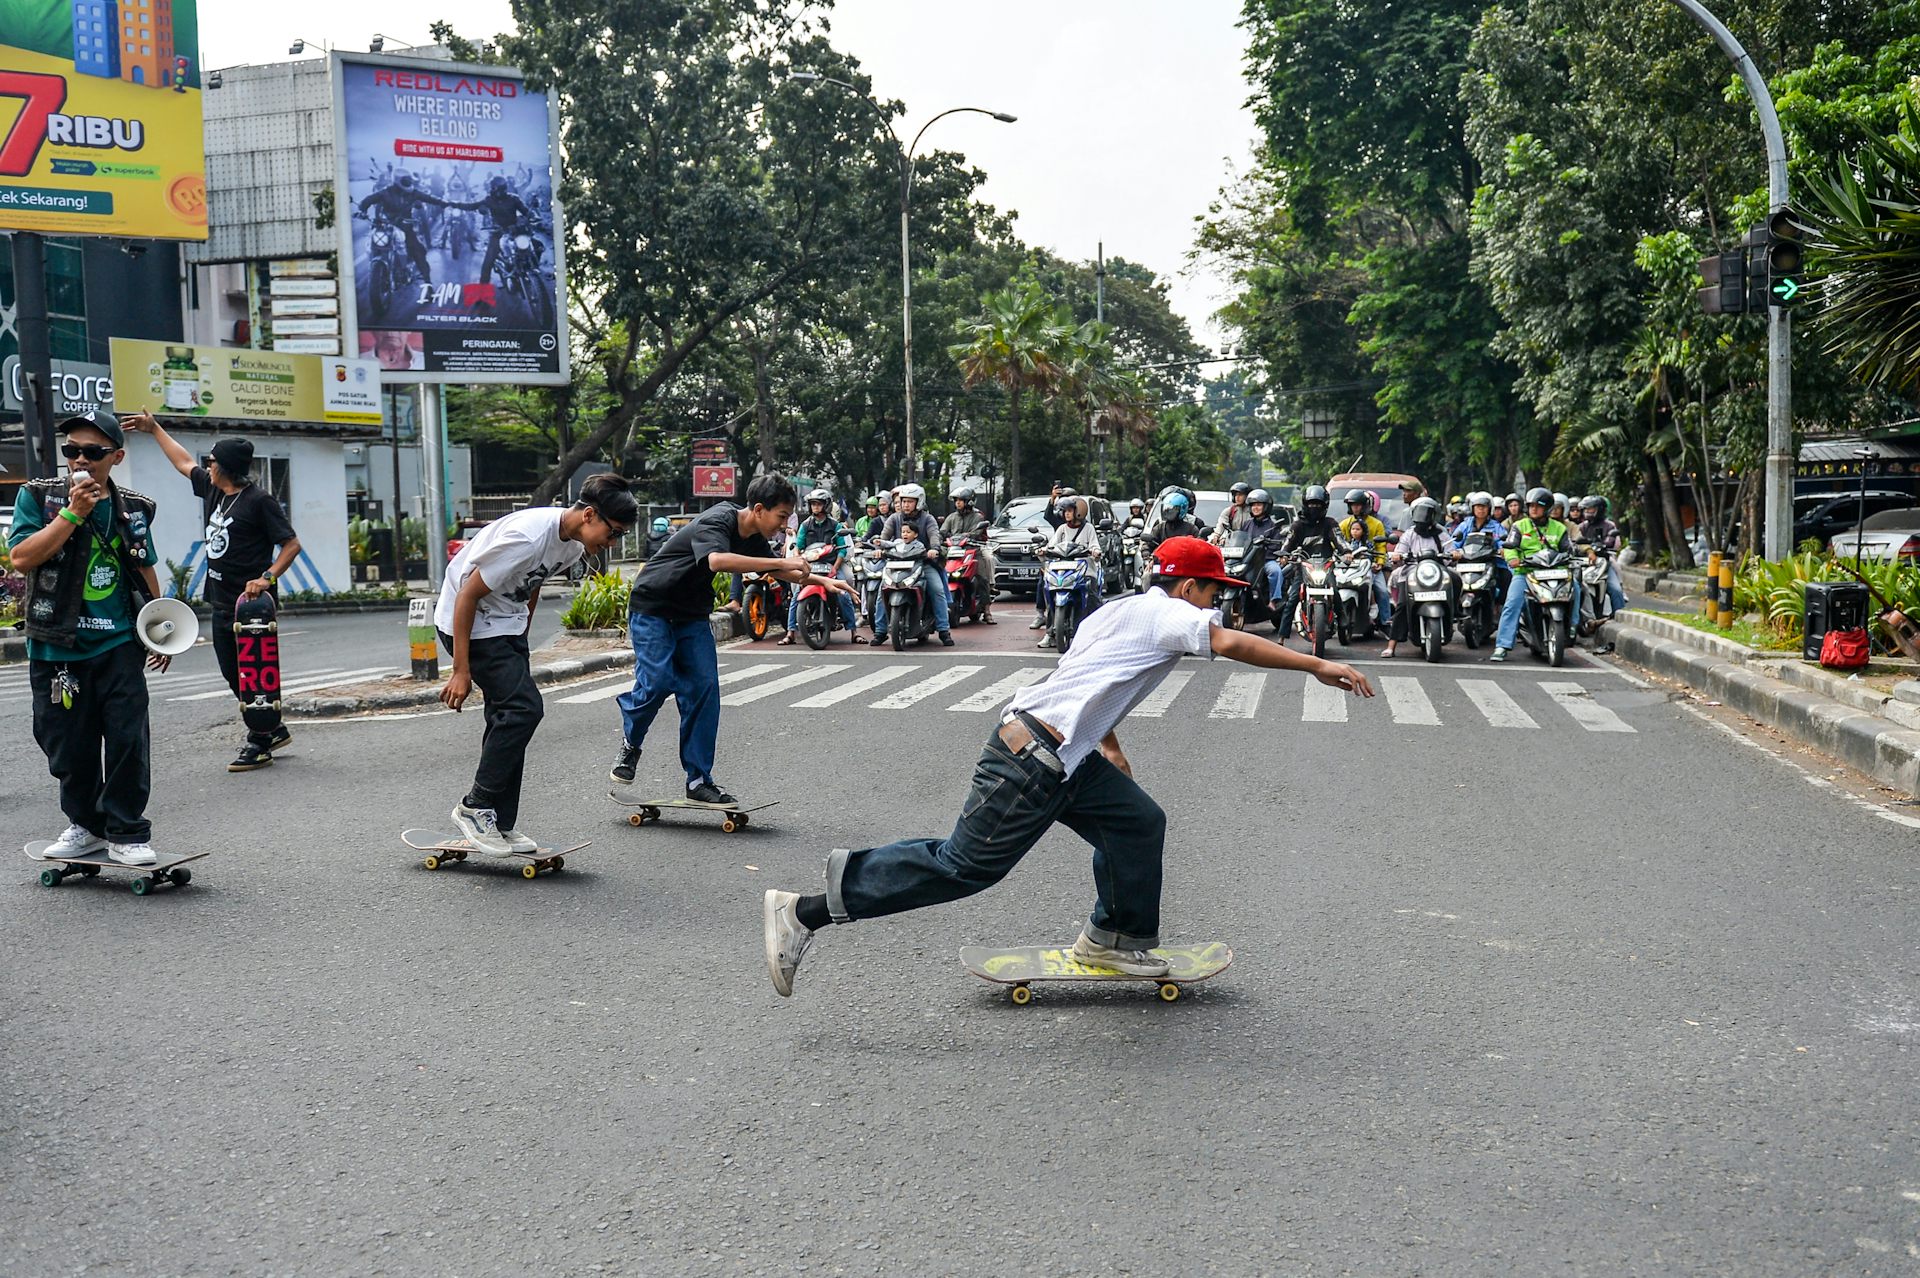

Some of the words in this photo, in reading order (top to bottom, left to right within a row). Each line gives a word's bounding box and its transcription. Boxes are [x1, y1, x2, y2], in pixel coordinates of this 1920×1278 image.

[374, 70, 517, 98] REDLAND
[394, 94, 445, 115] WHERE
[449, 98, 501, 120] RIDERS
[47, 114, 144, 151] RIBU
[421, 117, 477, 138] BELONG
[402, 143, 417, 153] RIDE
[446, 147, 454, 156] AT
[114, 166, 155, 175] superbank
[21, 191, 88, 211] Sekarang!
[416, 314, 457, 322] FILTER
[462, 340, 521, 349] PERINGATAN:
[245, 372, 279, 382] NATURAL
[230, 383, 261, 394] CALCI
[264, 385, 295, 396] BONE
[235, 397, 268, 406] Bergerak
[242, 407, 265, 416] Tanpa
[267, 408, 287, 417] Batas
[410, 601, 426, 611] STA
[87, 617, 113, 625] TODAY
